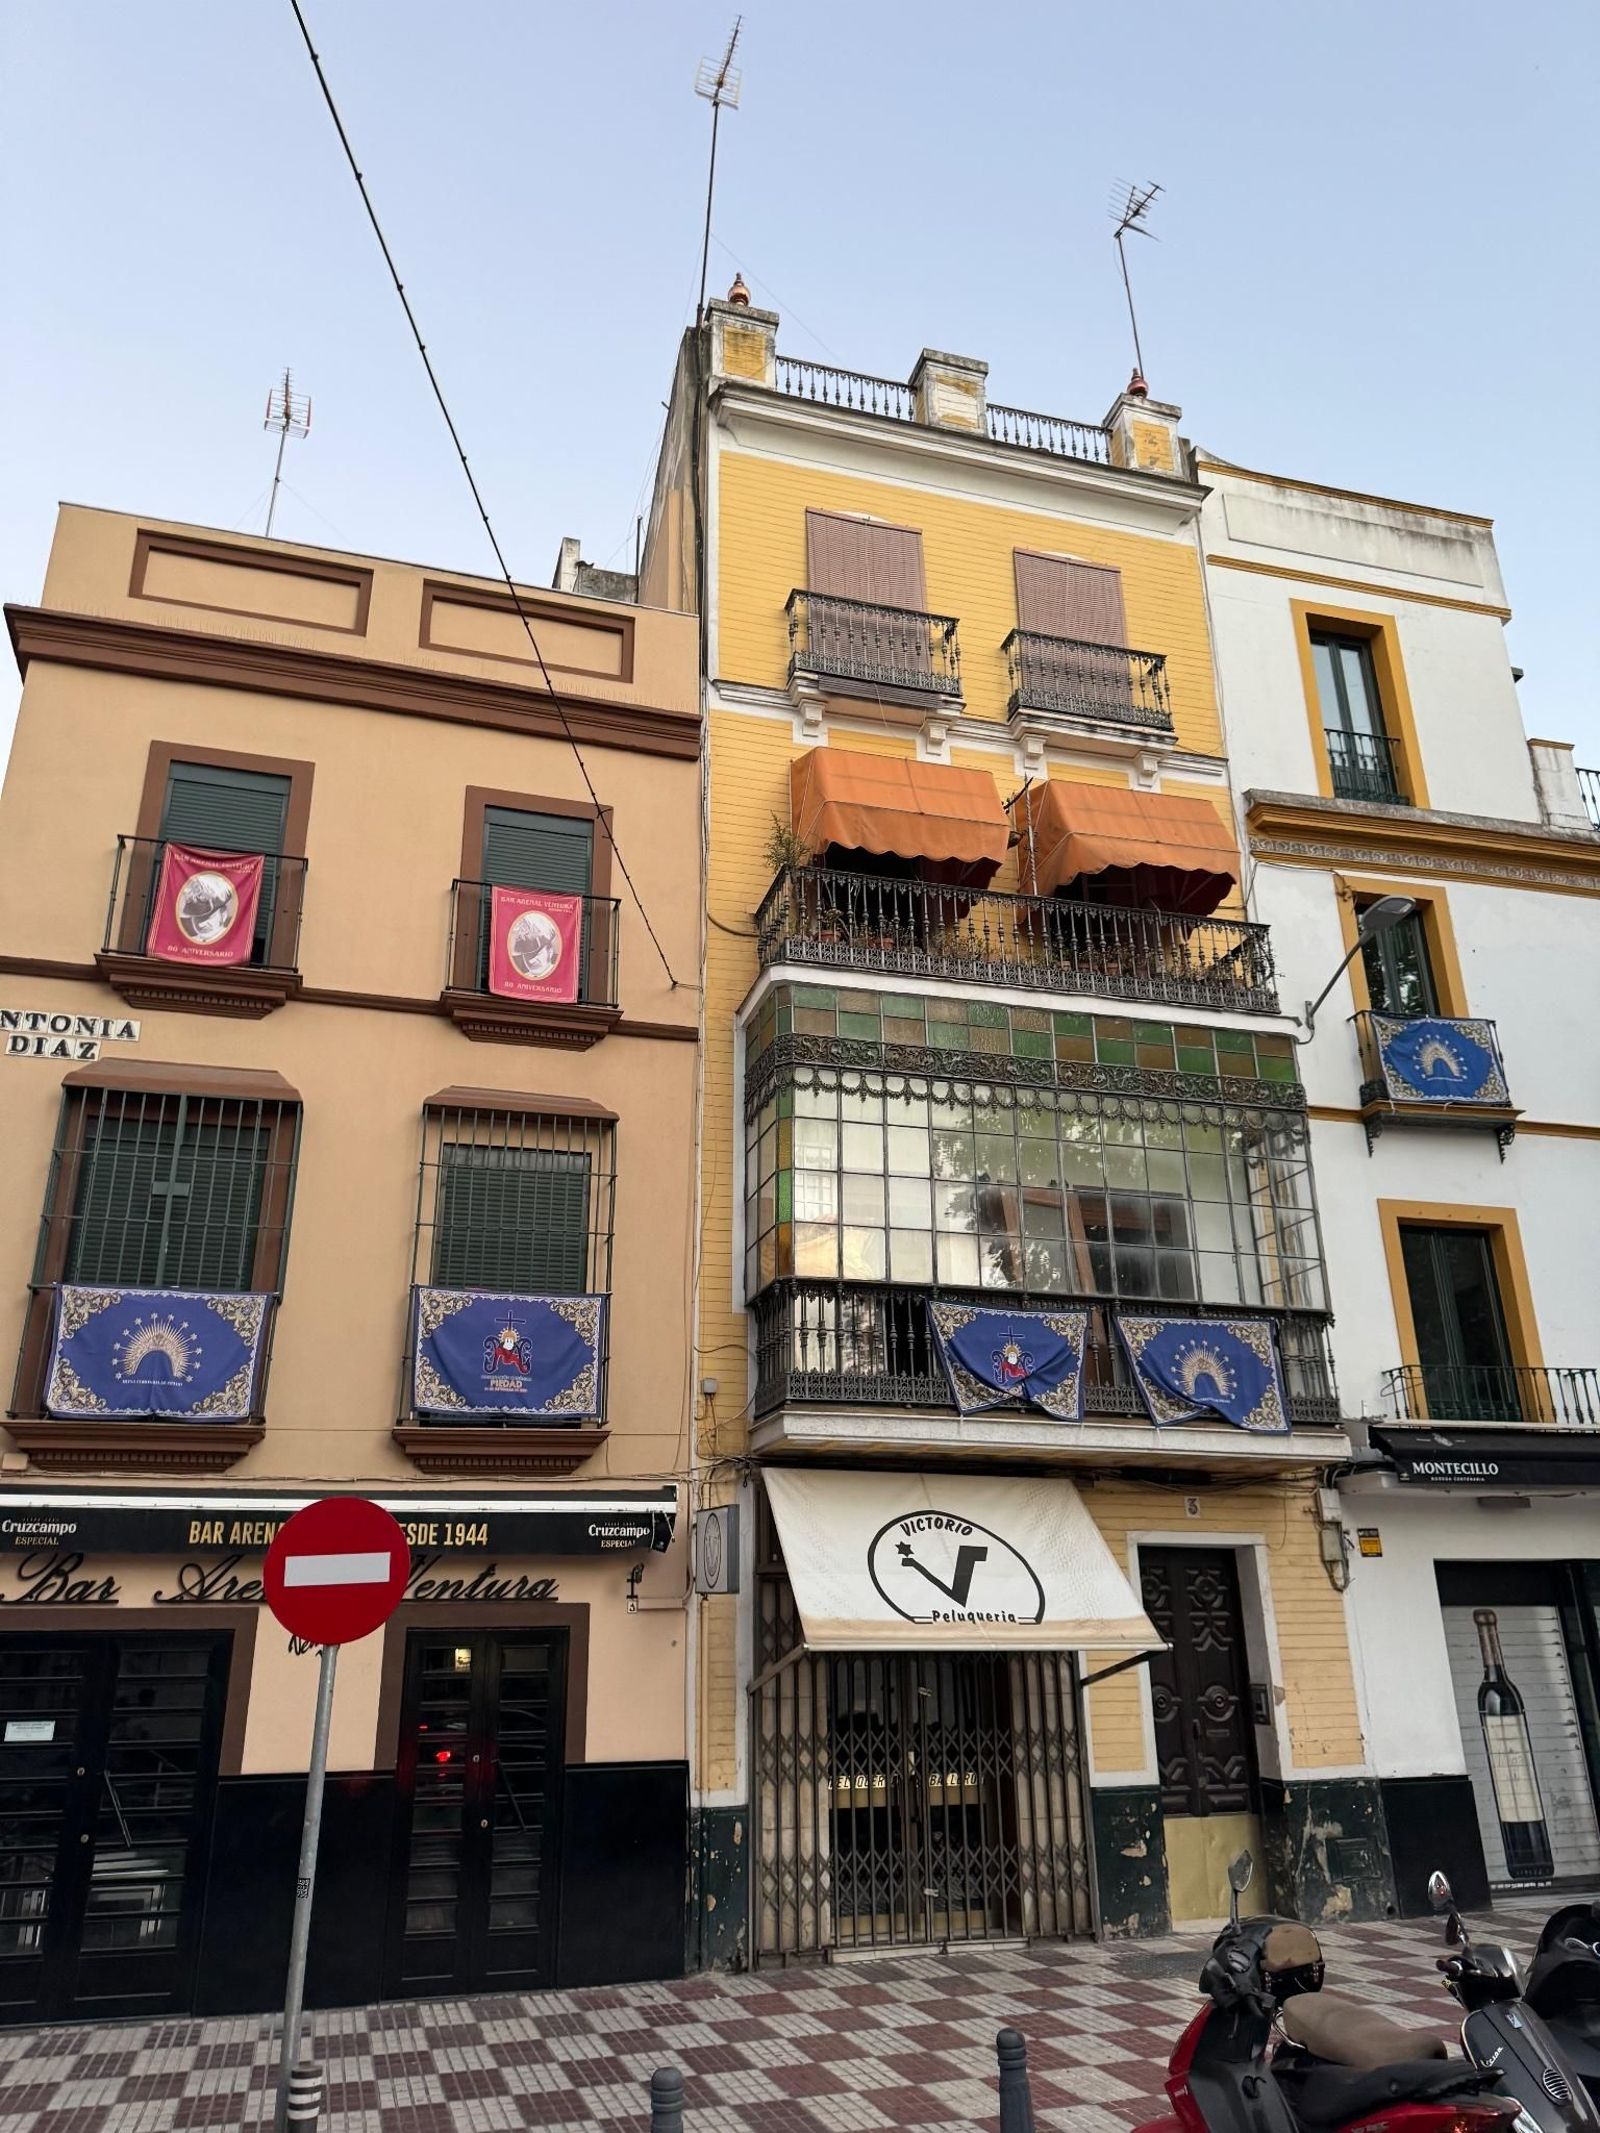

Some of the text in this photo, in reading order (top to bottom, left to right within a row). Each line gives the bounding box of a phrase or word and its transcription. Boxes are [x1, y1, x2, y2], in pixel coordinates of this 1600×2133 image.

[181, 947, 234, 957] ANIVERSARIO
[517, 982, 562, 993] ANIVERSARIO
[9, 1035, 98, 1059] DIAZ
[490, 1379, 523, 1388] PIEDAD
[1412, 1461, 1499, 1475] MONTECILLO
[1187, 1497, 1198, 1516] 3
[2, 1518, 77, 1535] Cruzcampo
[188, 1520, 224, 1545] BAR
[443, 1522, 488, 1546] 1944
[588, 1523, 651, 1538] Cruzcampo
[900, 1517, 973, 1537] VICTORIO
[15, 1536, 59, 1546] ESPECIAL
[0, 1552, 121, 1603] Bar
[152, 1554, 266, 1604] Are
[932, 1609, 1017, 1625] Peluqueria
